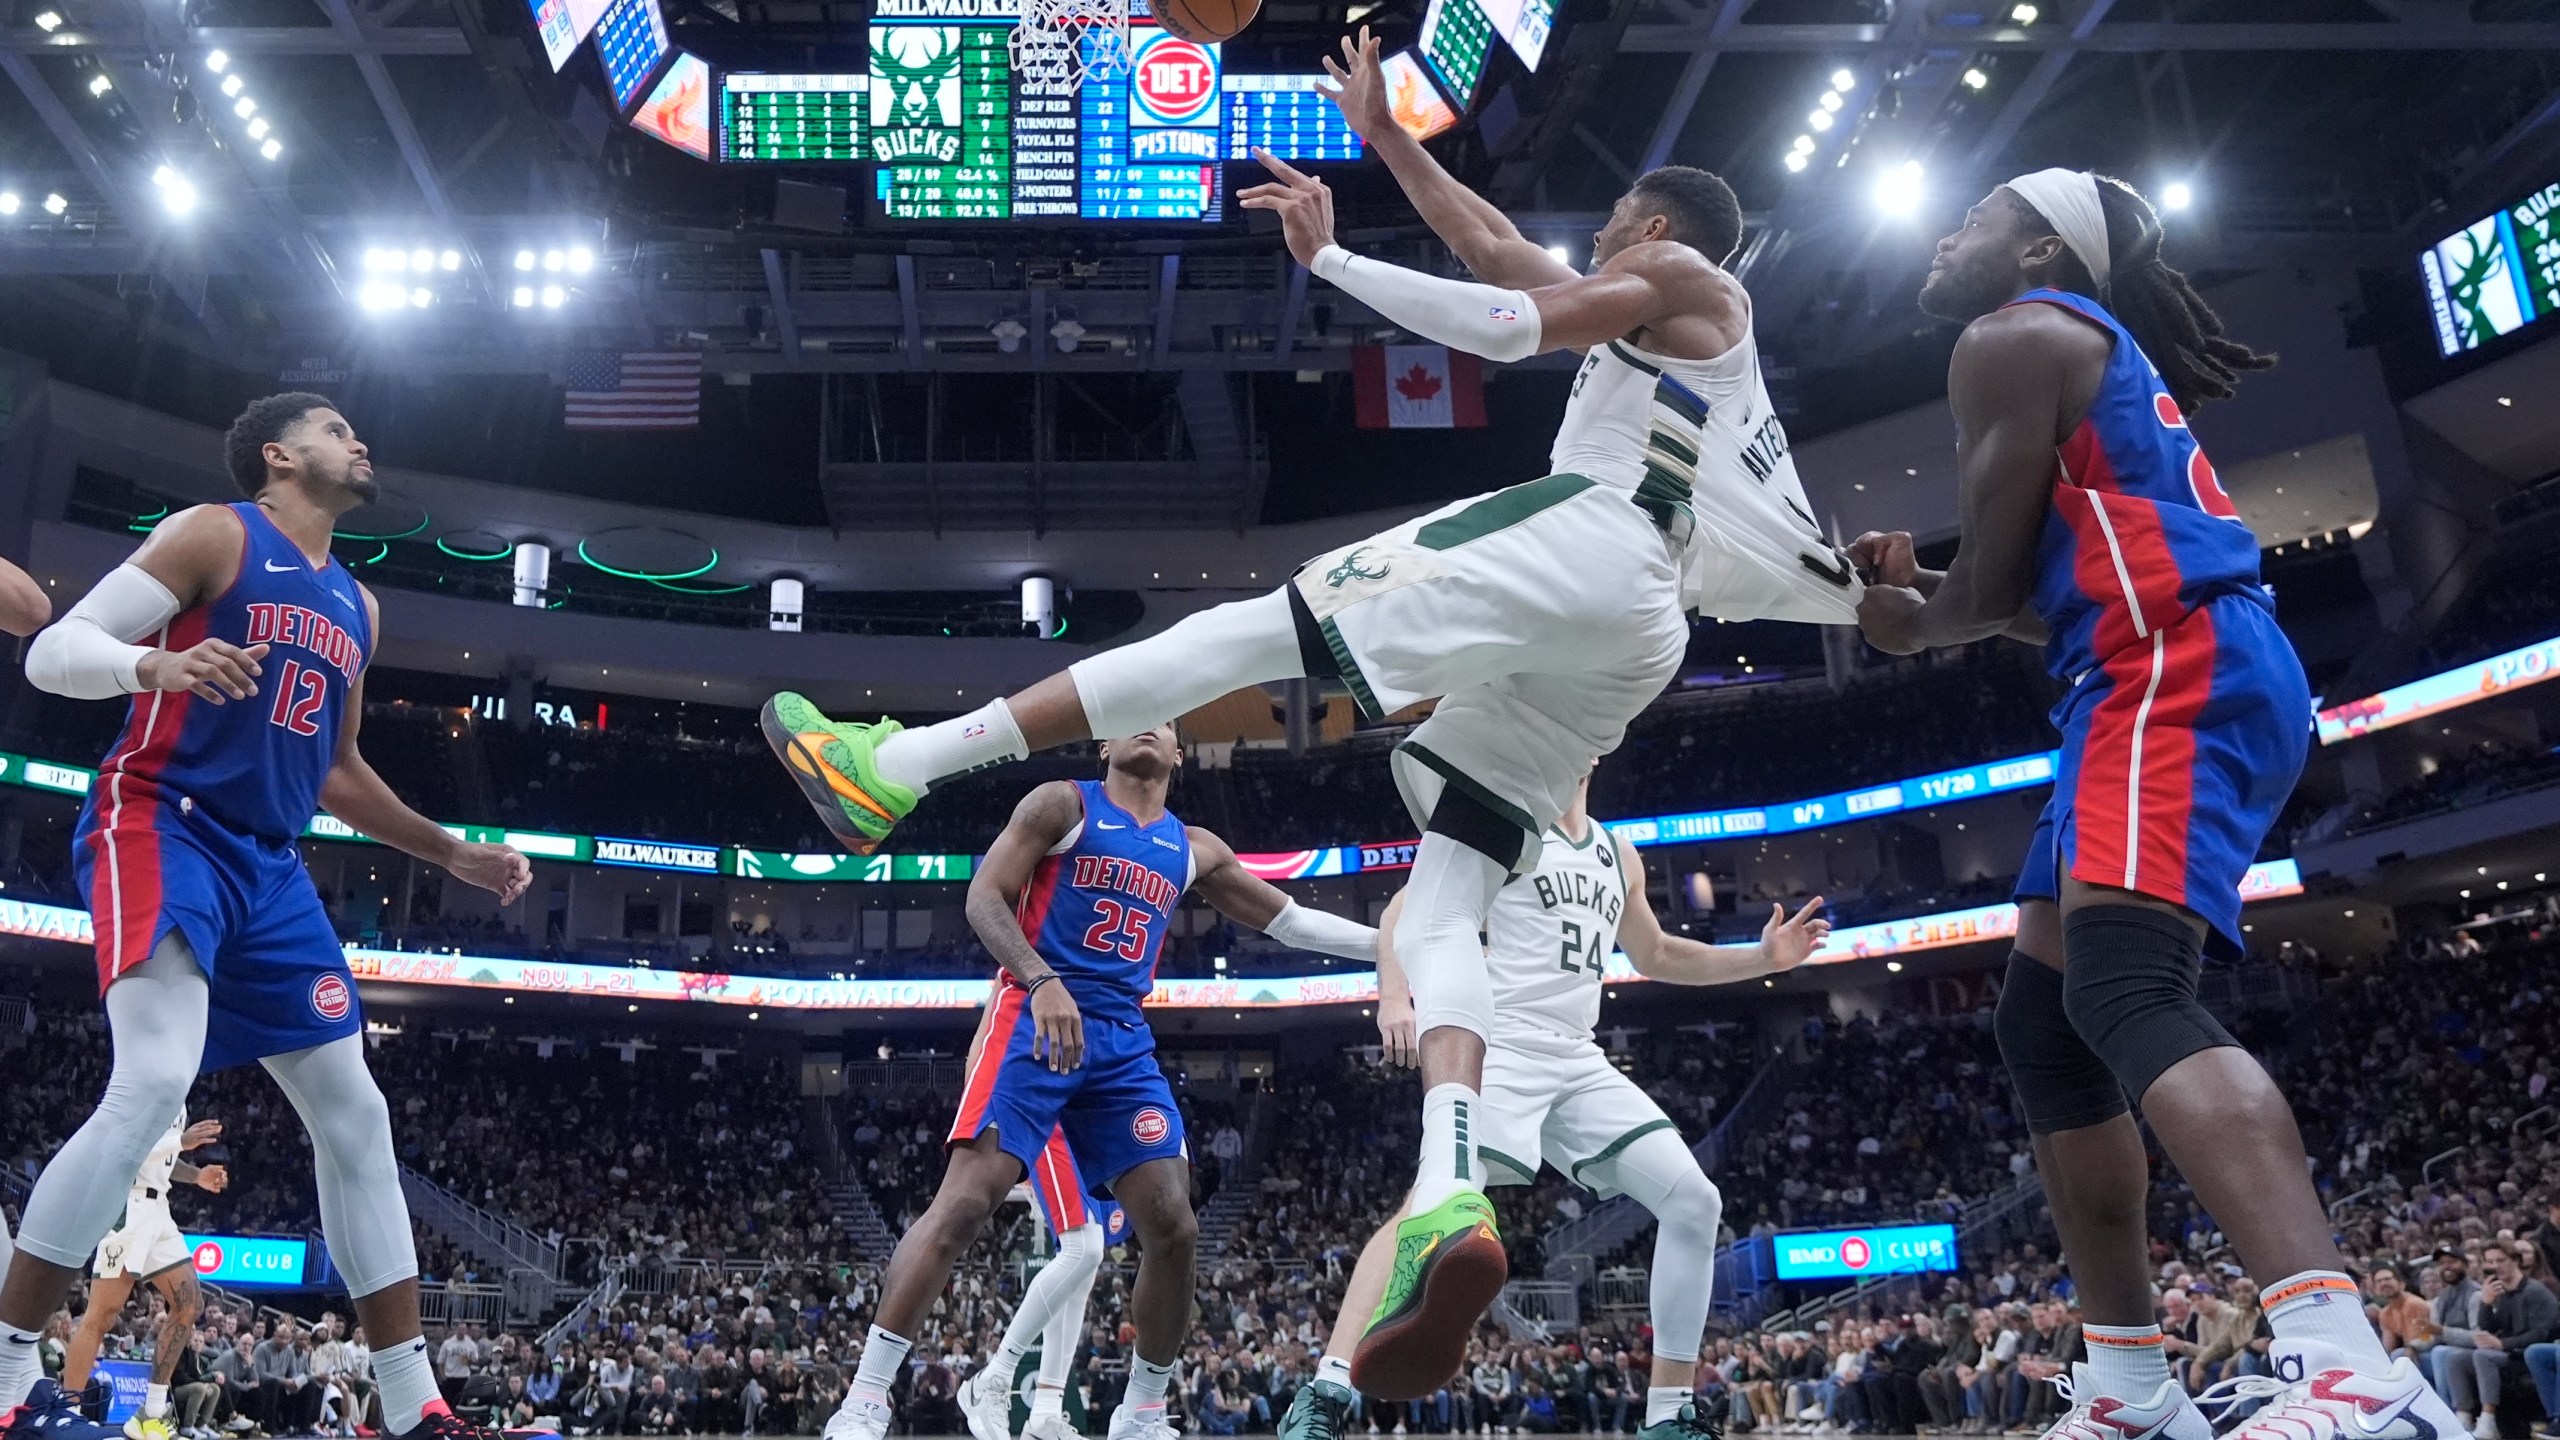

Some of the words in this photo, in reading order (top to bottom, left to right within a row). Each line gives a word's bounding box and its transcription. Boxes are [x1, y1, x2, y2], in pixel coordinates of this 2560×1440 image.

[981, 67, 990, 80] 7
[1147, 63, 1203, 94] DET
[981, 84, 990, 97] 7
[796, 92, 804, 104] 2
[824, 92, 831, 104] 1
[1235, 92, 1244, 105] 2
[1290, 92, 1299, 105] 3
[738, 106, 753, 118] 12
[796, 106, 805, 118] 3
[823, 106, 831, 118] 2
[849, 106, 858, 118] 2
[978, 102, 993, 115] 22
[1020, 100, 1045, 112] DEF
[1045, 101, 1070, 112] REB
[1098, 102, 1113, 115] 22
[1232, 106, 1248, 118] 12
[1317, 106, 1325, 118] 3
[796, 120, 805, 132] 3
[824, 120, 832, 132] 1
[1014, 118, 1076, 130] TURNOVERS
[1291, 119, 1298, 132] 1
[796, 132, 805, 144] 7
[824, 132, 832, 144] 1
[872, 128, 960, 162] BUCKS
[1016, 134, 1053, 146] TOTAL
[1054, 134, 1075, 146] FLS
[1098, 136, 1113, 149] 12
[1132, 130, 1217, 159] PISTONS
[1263, 132, 1271, 146] 2
[1317, 132, 1325, 146] 1
[770, 146, 779, 159] 2
[797, 146, 805, 159] 1
[823, 146, 832, 159] 2
[849, 146, 858, 159] 2
[1016, 152, 1053, 164] BENCH
[1054, 152, 1075, 164] PTS
[1290, 146, 1298, 159] 3
[1343, 146, 1351, 159] 1
[1015, 169, 1044, 180] FIELD
[1044, 169, 1075, 180] GOALS
[1018, 186, 1073, 197] 3-POINTERS
[1013, 203, 1037, 214] FREE
[1038, 203, 1078, 214] THROWS
[246, 602, 362, 688] DETROIT
[269, 658, 328, 737] 12
[45, 769, 80, 786] 3PT
[596, 841, 717, 868] MILWAUKEE
[1362, 845, 1420, 867] DET
[917, 855, 946, 879] 71
[1072, 856, 1180, 919] DETROIT
[1533, 871, 1621, 926] BUCKS
[1083, 898, 1152, 962] 25
[1560, 920, 1604, 981] 24
[318, 986, 344, 999] DETROIT
[767, 982, 957, 1006] POTAWATOMI
[320, 994, 346, 1008] PISTONS
[1137, 1118, 1161, 1129] DETROIT
[1138, 1124, 1163, 1135] PISTONS
[1788, 1246, 1836, 1265] BMO
[1888, 1238, 1944, 1259] CLUB
[241, 1251, 294, 1270] CLUB
[115, 1376, 148, 1394] FANDUE
